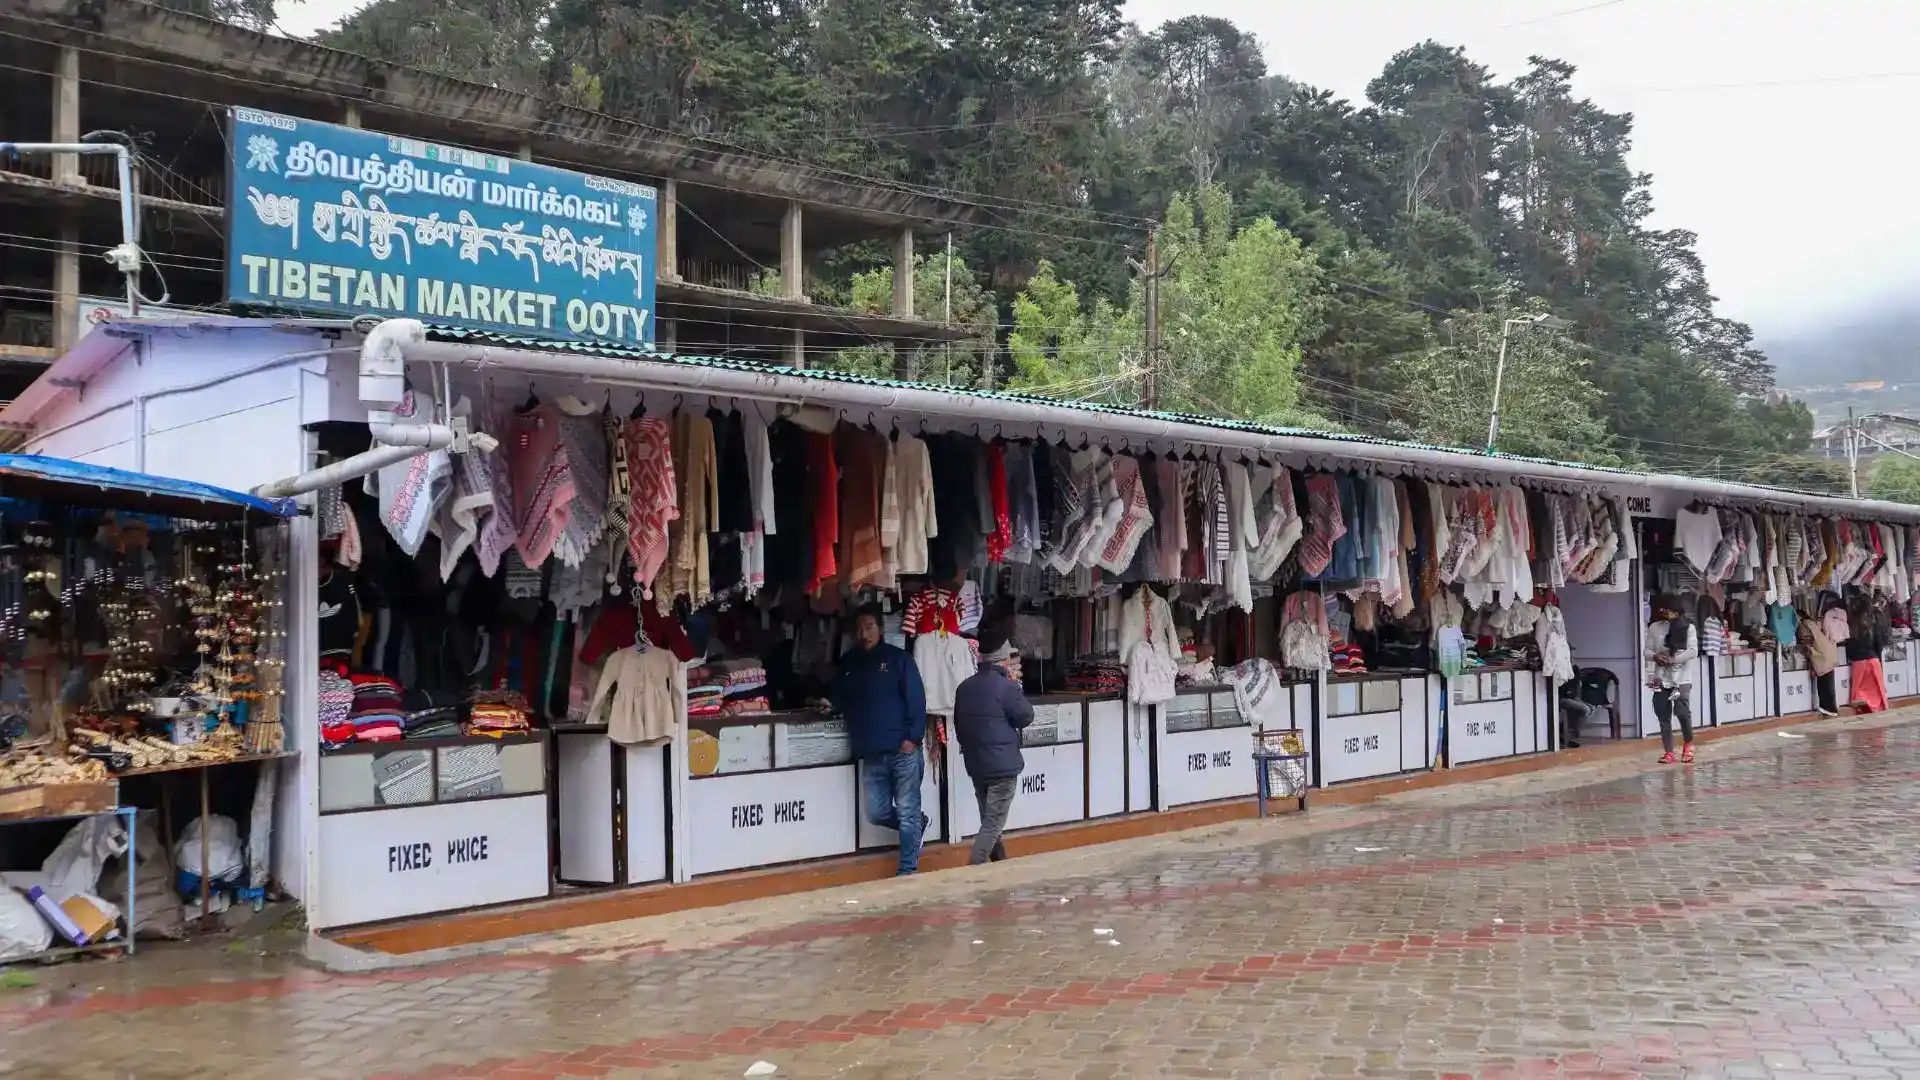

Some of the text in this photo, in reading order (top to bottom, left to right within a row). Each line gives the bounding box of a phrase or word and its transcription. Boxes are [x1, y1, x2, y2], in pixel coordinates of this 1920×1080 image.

[272, 116, 296, 131] 1975
[285, 141, 622, 228] திபெத்தியன் மார்க்கெட்
[241, 254, 648, 340] TIBETAN MARKET OOTY
[1626, 496, 1651, 513] COME
[1188, 750, 1231, 772] FIXED PRICE
[1022, 773, 1045, 794] PRICE
[732, 800, 805, 829] FIXED PRICE
[388, 835, 488, 873] FIXED PRICE
